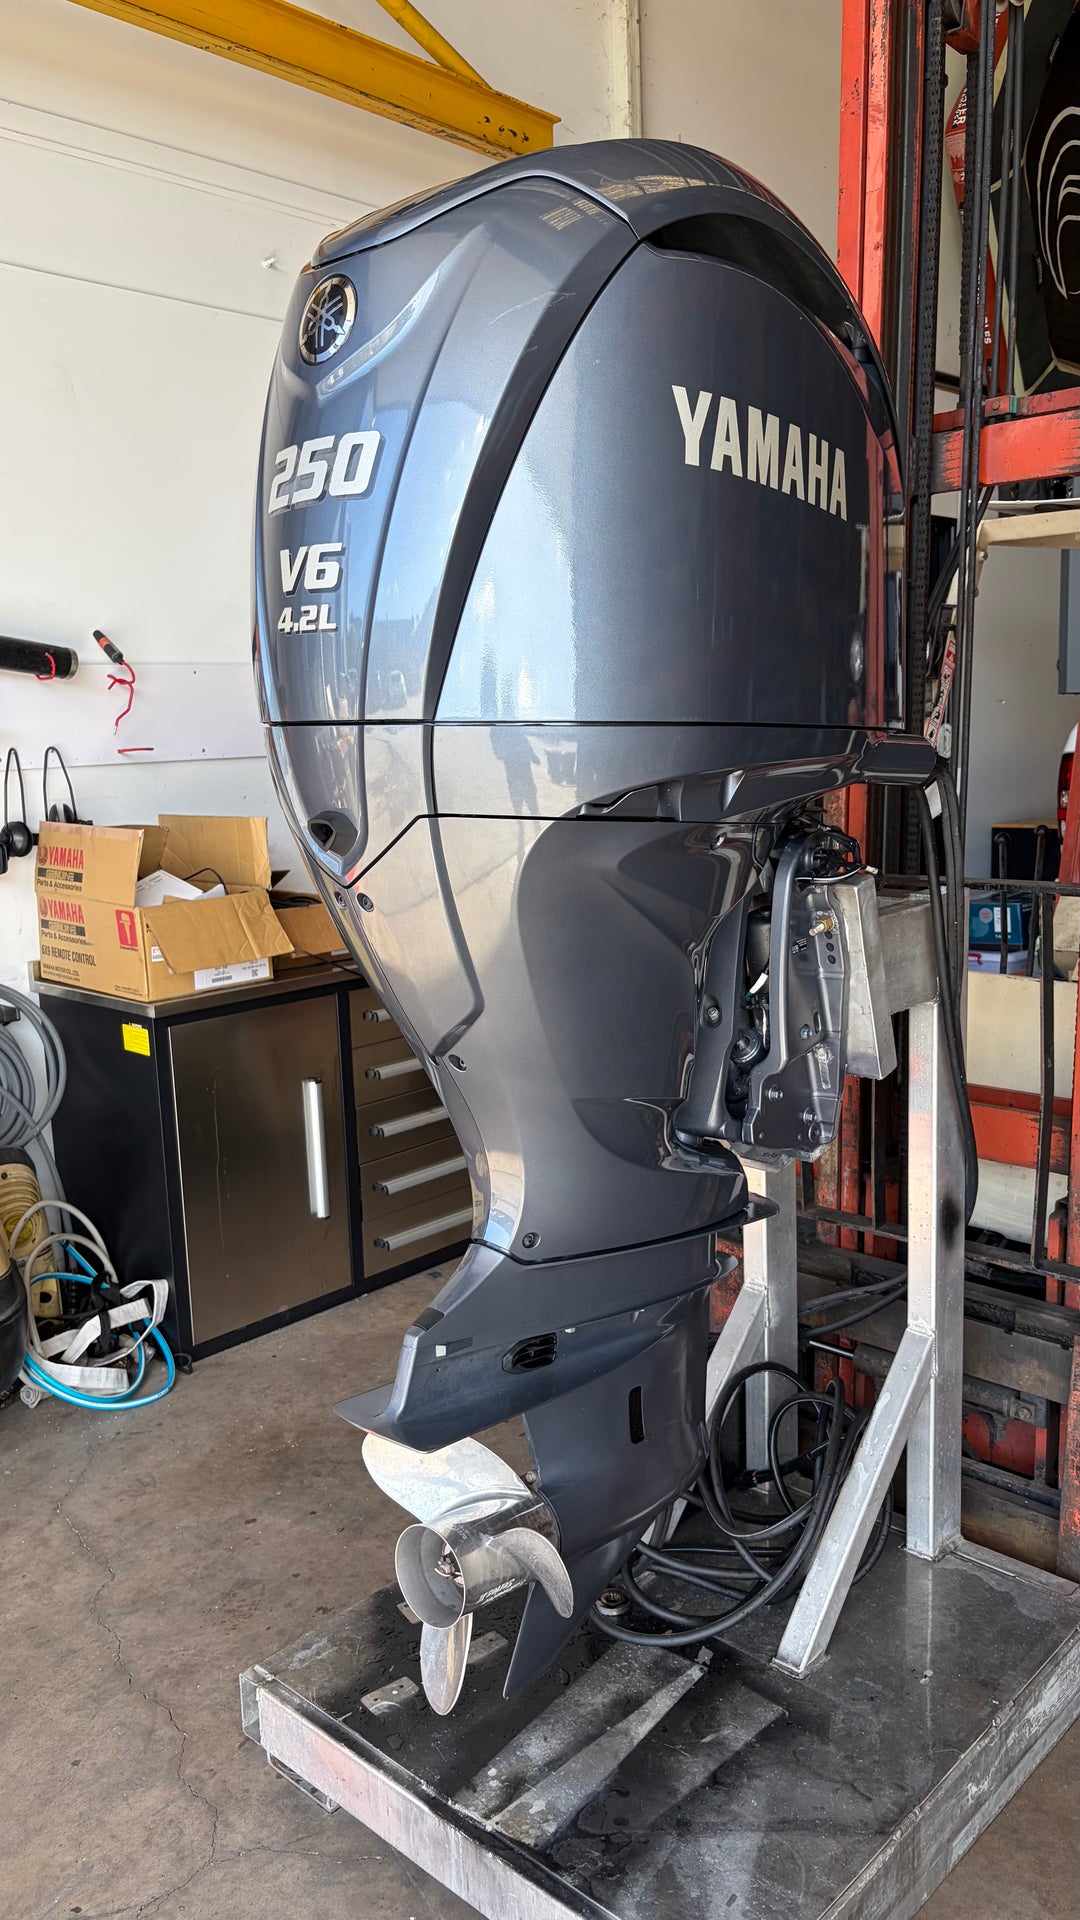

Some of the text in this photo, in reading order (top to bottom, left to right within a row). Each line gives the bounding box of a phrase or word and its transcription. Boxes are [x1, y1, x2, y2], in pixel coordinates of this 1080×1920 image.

[672, 384, 847, 522] YAMAHA
[268, 430, 384, 515] 250
[279, 543, 344, 594] V6
[277, 604, 338, 633] 4.2L
[49, 846, 84, 869] YAMAHA
[37, 878, 49, 887] Parts
[54, 881, 82, 892] Accessories
[46, 869, 75, 882] GENUINE
[47, 898, 85, 925] YAMAHA
[41, 929, 53, 939] Parts
[58, 933, 87, 946] Accessories
[51, 946, 71, 962] REMOTE
[71, 951, 96, 967] CONTROL
